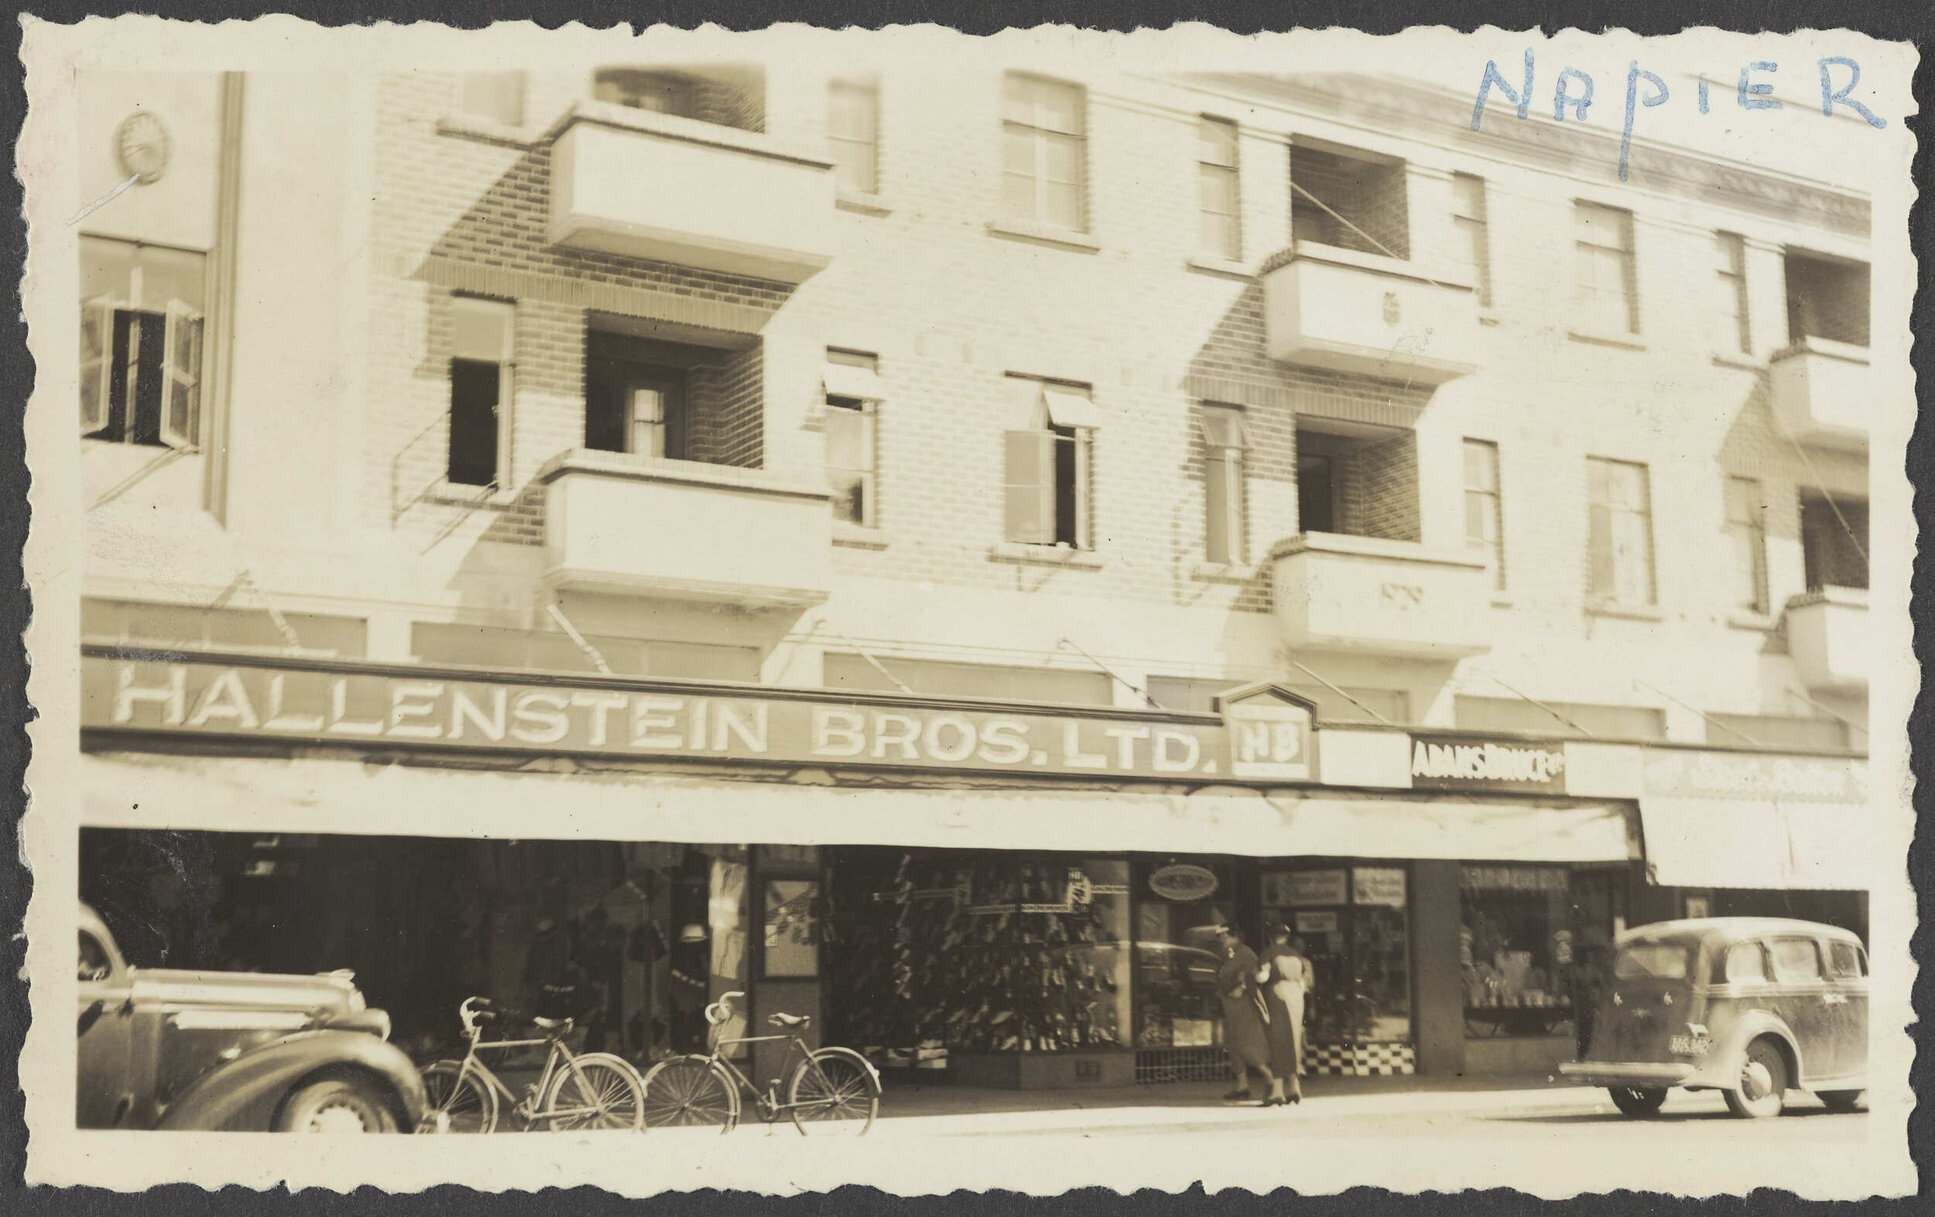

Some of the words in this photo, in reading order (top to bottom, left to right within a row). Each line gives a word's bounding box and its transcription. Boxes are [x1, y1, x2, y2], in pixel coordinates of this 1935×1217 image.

[113, 662, 768, 753] HALLENSTEIN
[812, 709, 1048, 766] BROS.
[1062, 723, 1218, 775] LTD.
